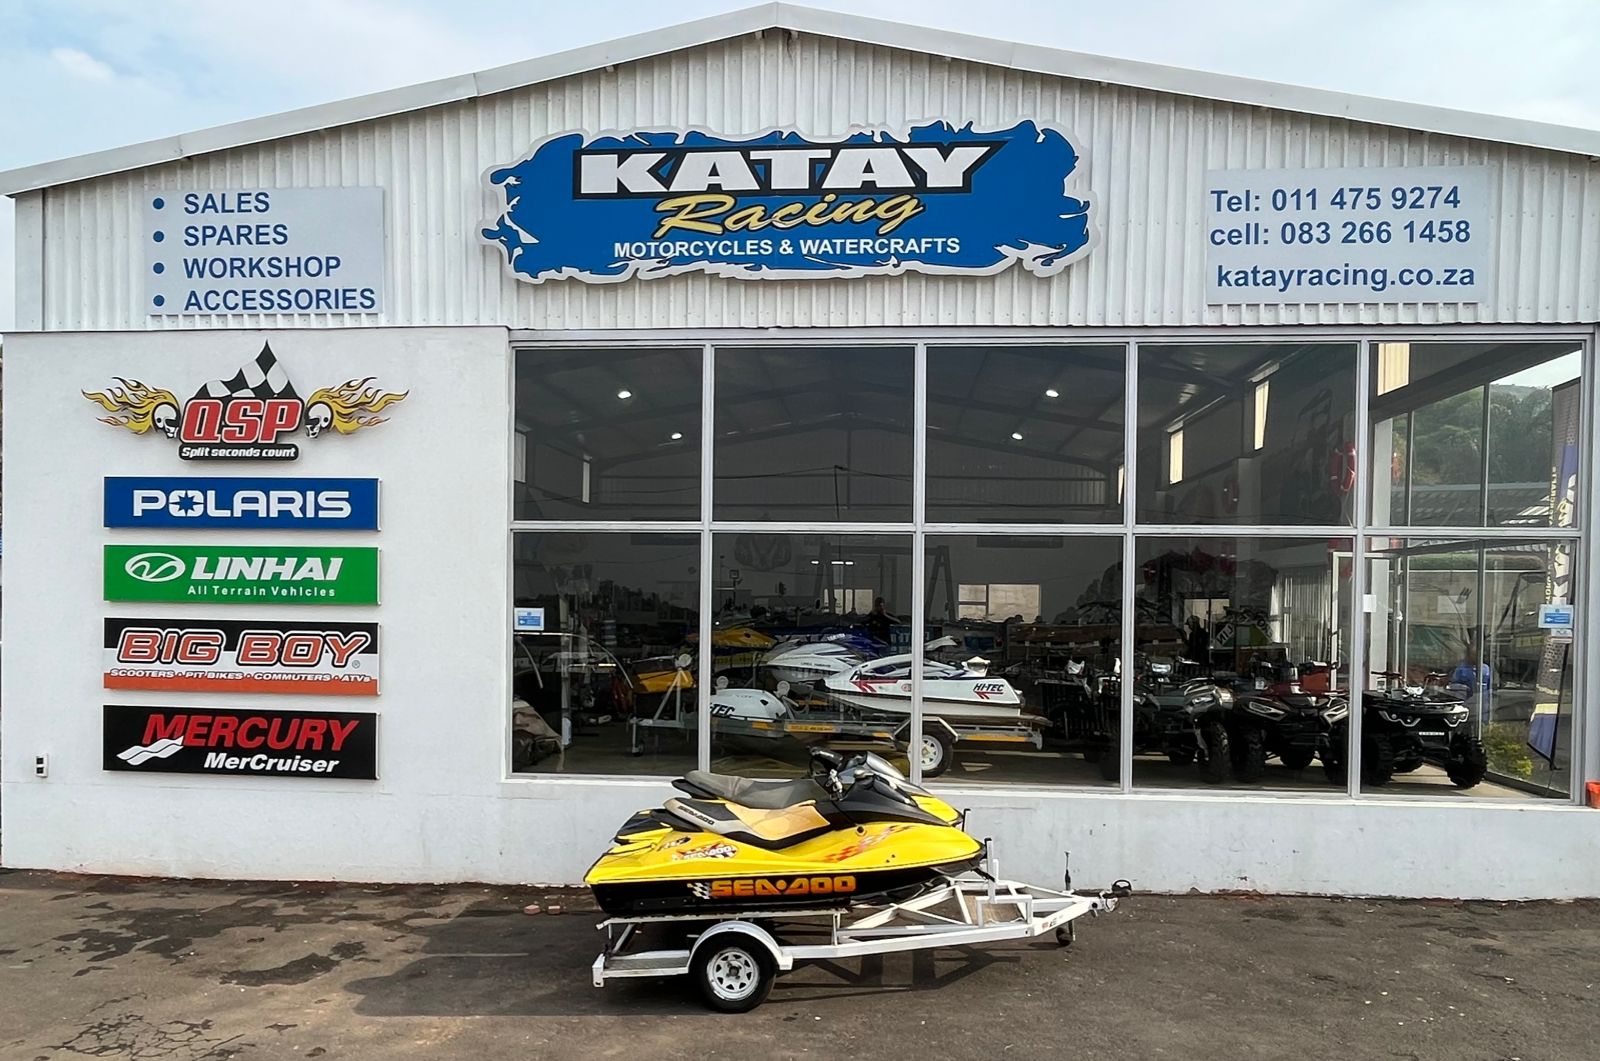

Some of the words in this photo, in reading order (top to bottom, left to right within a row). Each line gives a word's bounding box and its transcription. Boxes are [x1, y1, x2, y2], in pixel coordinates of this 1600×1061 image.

[580, 146, 992, 194] KATAY
[183, 191, 271, 214] SALES
[1210, 189, 1260, 212] Tel:
[1271, 188, 1318, 211] 011
[1330, 187, 1382, 210] 475
[1391, 185, 1461, 209] 9274
[652, 193, 924, 239] Racing
[183, 223, 288, 246] SPARES
[1209, 222, 1270, 245] cell:
[1280, 222, 1331, 245] 083
[1341, 221, 1392, 244] 266
[1402, 220, 1471, 243] 1458
[613, 239, 773, 258] MOTORCYCLES
[779, 238, 794, 255] &
[799, 237, 961, 255] WATERCRAFTS
[183, 256, 341, 279] WORKSHOP
[1217, 263, 1475, 292] katayracing.co.za
[184, 288, 376, 311] ACCESSORIES
[181, 398, 302, 444] QSP
[181, 447, 210, 458] Split
[211, 447, 261, 457] seconds
[261, 447, 296, 457] count
[132, 489, 352, 518] POLARIS
[190, 556, 344, 581] LINHAI
[187, 585, 208, 595] All
[212, 585, 266, 596] Terrain
[271, 586, 336, 597] Vehicles
[118, 630, 224, 664] BIG
[236, 632, 368, 667] BOY
[109, 668, 176, 679] SCOOTERS
[184, 671, 205, 679] PIT
[206, 671, 243, 680] BIKES
[254, 672, 332, 682] COMMUTERS
[973, 682, 1004, 692] HI-TEC
[142, 714, 360, 751] MERCURY
[203, 752, 340, 773] MerCruiser
